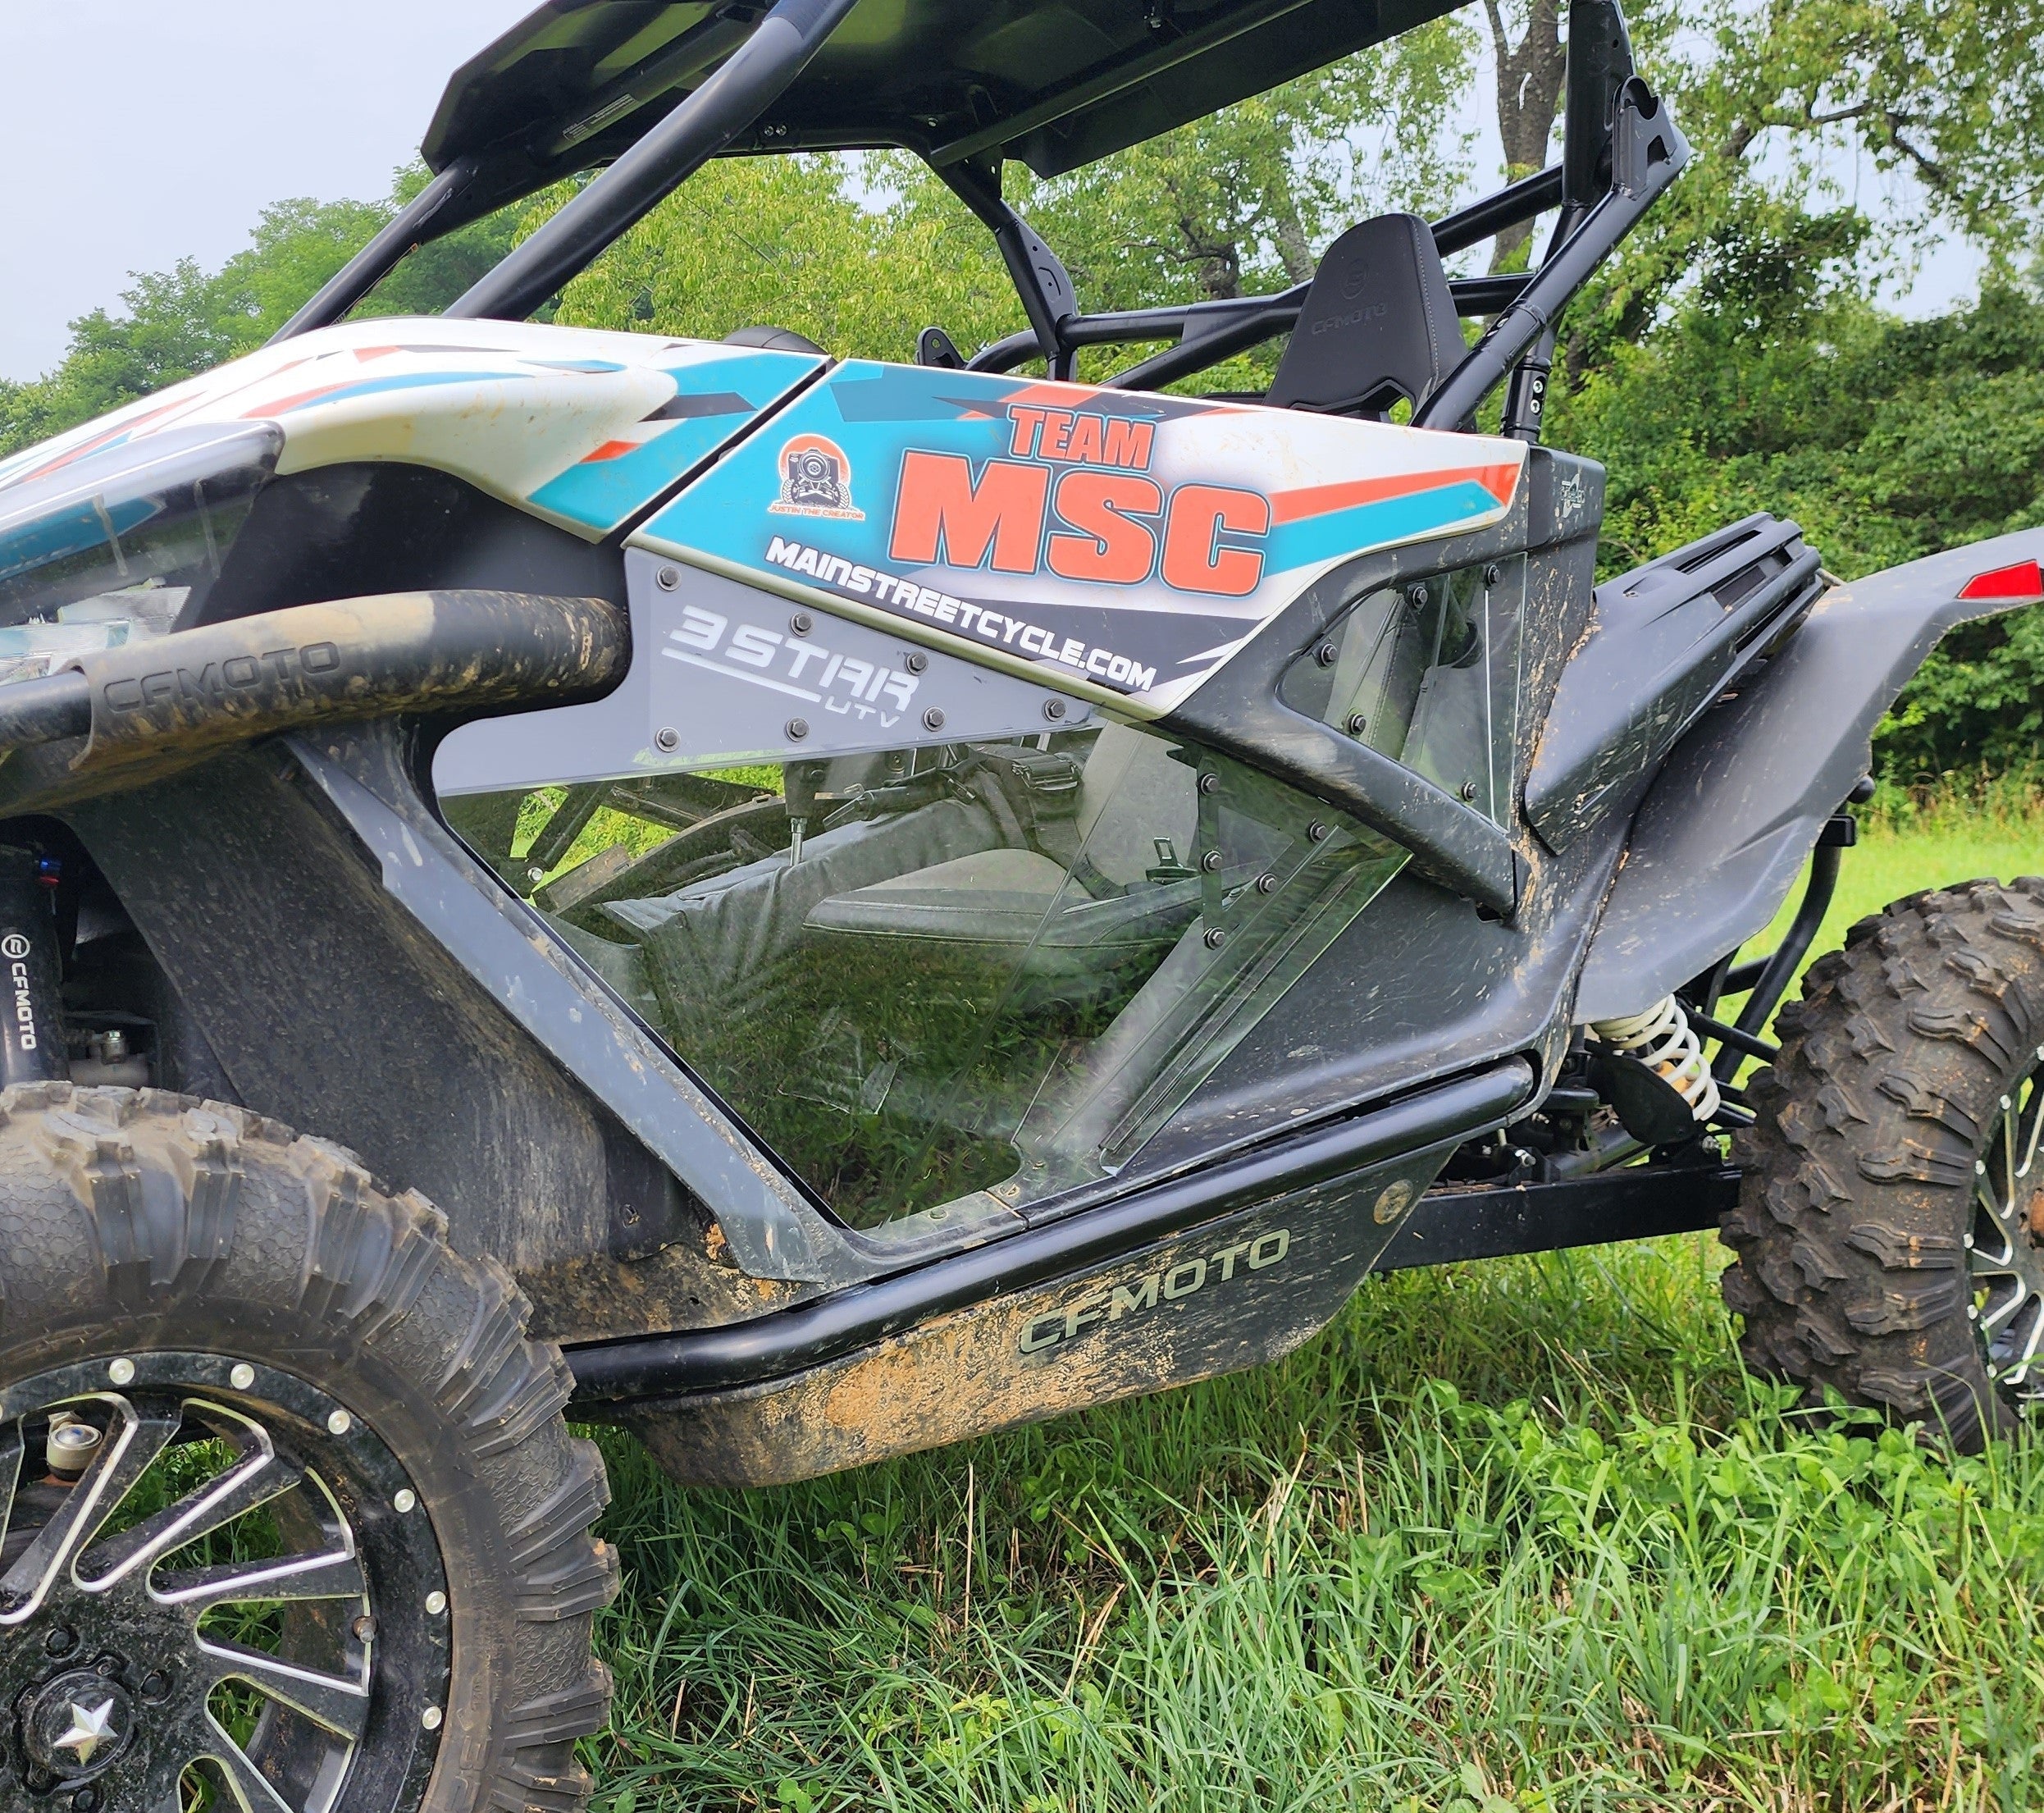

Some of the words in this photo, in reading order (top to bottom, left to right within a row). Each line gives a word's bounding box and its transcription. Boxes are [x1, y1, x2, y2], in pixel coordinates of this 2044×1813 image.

[1312, 302, 1386, 335] CFMOTO
[1008, 405, 1156, 469] TEAM
[769, 505, 801, 514] JUSTIN
[803, 507, 821, 515] THE
[823, 509, 865, 519] CREATOR
[889, 448, 1271, 596] MSC
[765, 537, 1157, 692] MAINSTREETCYCLE.COM
[103, 642, 340, 713] CFMOTO
[669, 605, 728, 651] 3
[725, 623, 920, 711] STAR
[824, 695, 901, 728] UTV
[11, 962, 37, 1050] CFMOTO
[1020, 1228, 1291, 1353] CFMOTO
